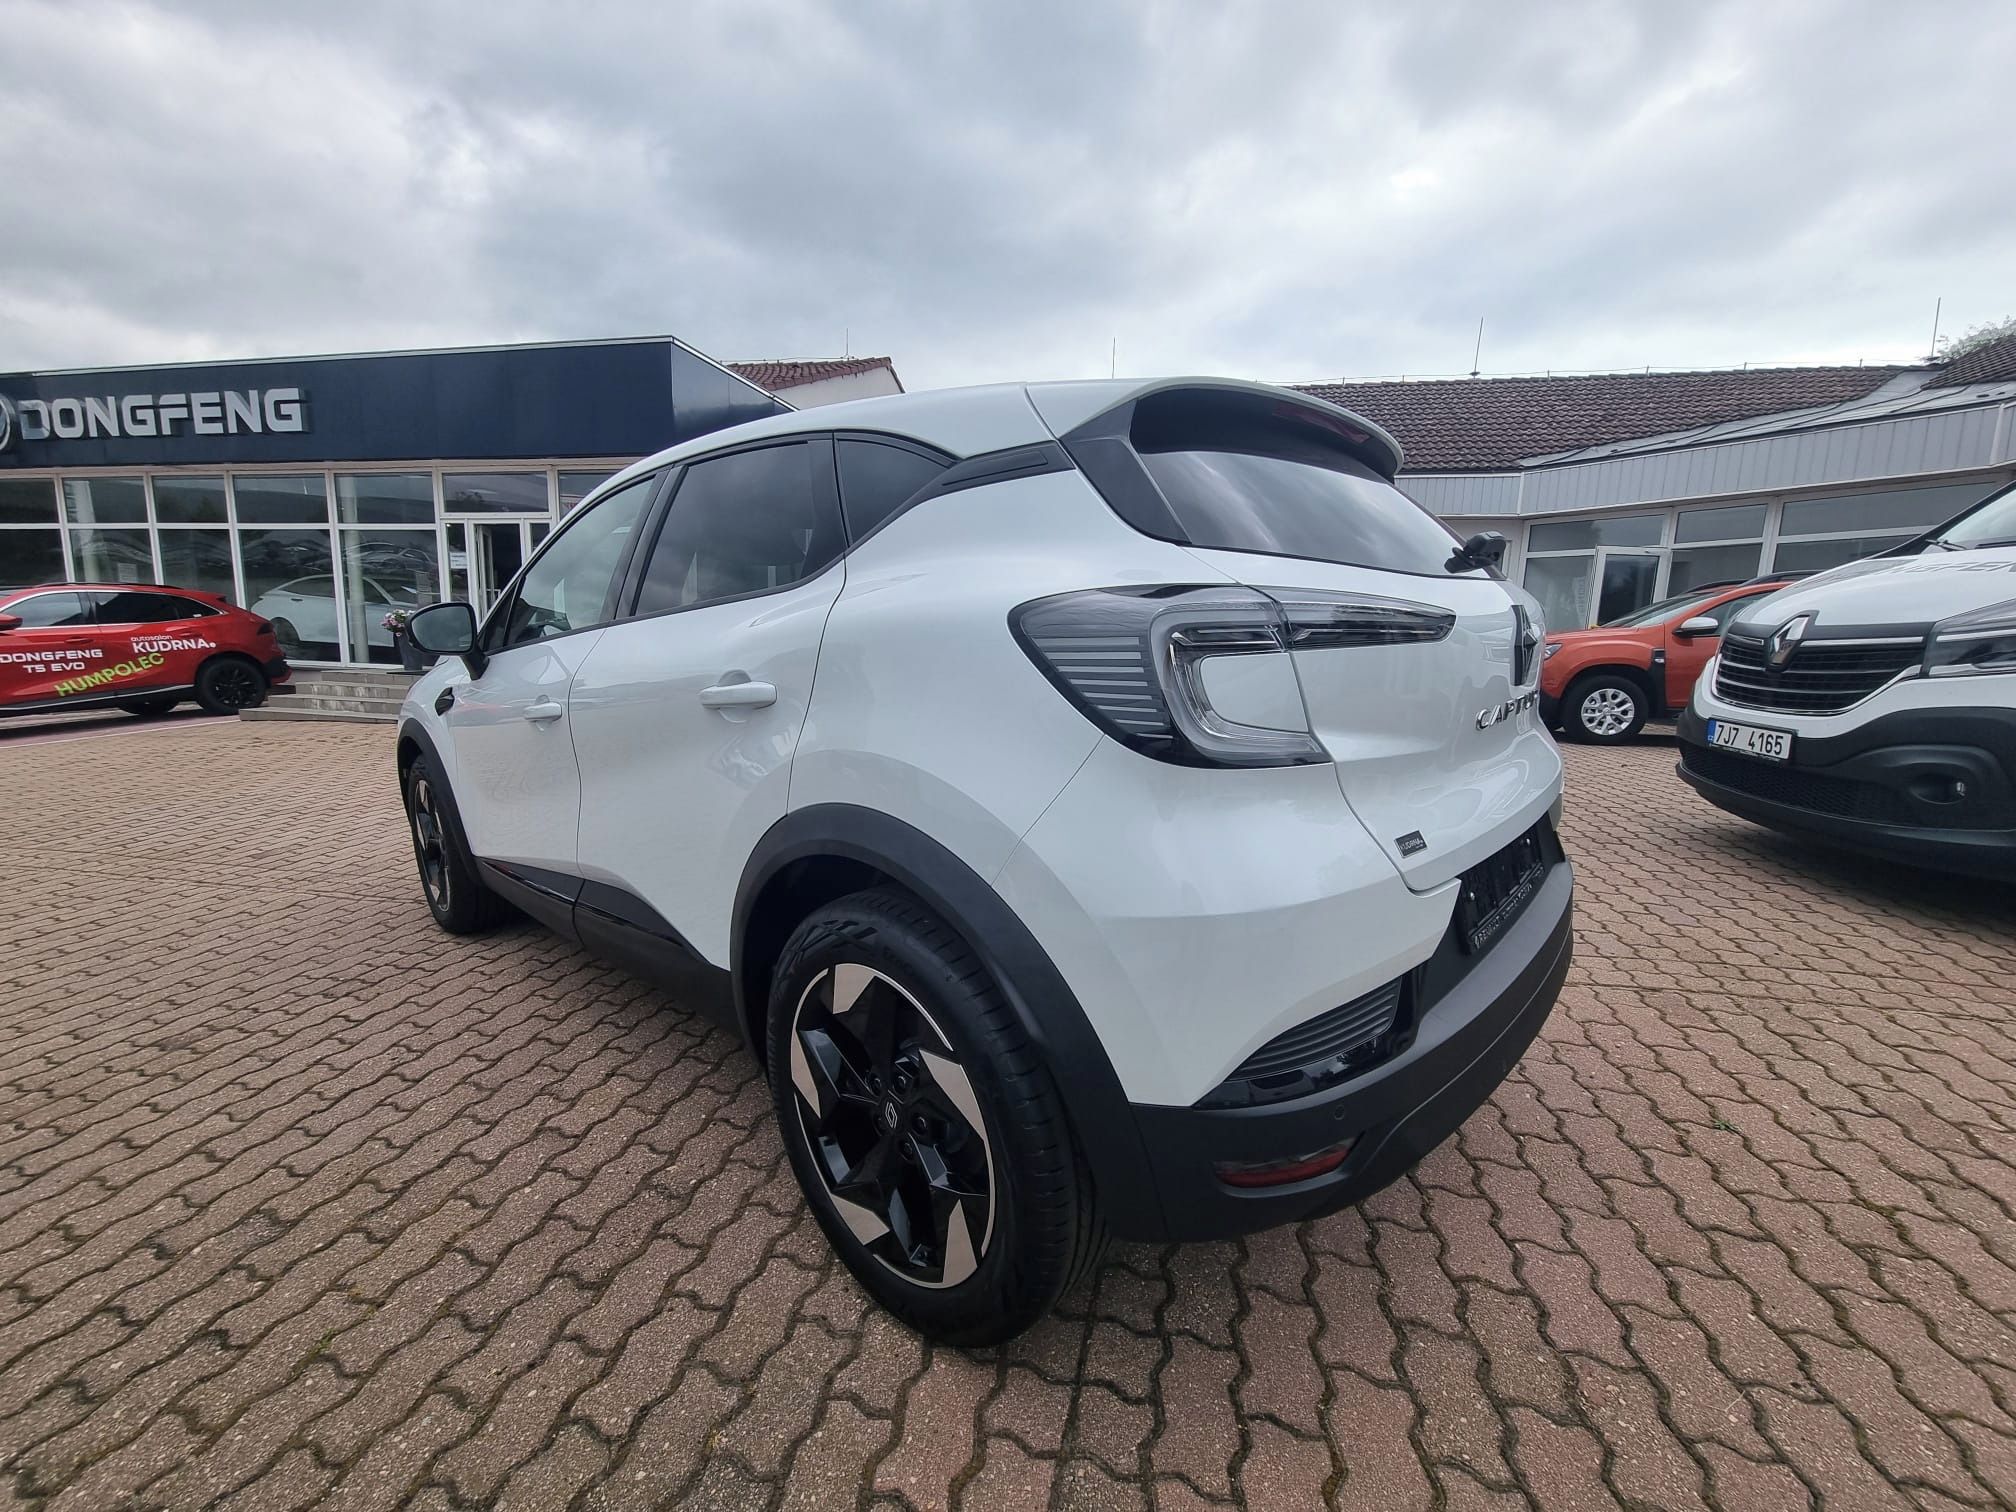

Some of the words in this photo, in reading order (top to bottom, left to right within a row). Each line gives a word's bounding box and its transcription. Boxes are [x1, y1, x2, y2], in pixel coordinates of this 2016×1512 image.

[18, 387, 303, 440] DONGFENG
[130, 634, 172, 643] autosalon
[0, 648, 103, 663] DONGFENG
[51, 662, 85, 672] EVO
[54, 652, 165, 697] HUMPOLEC
[1715, 724, 1740, 746] 7J7
[1747, 730, 1784, 755] 4165
